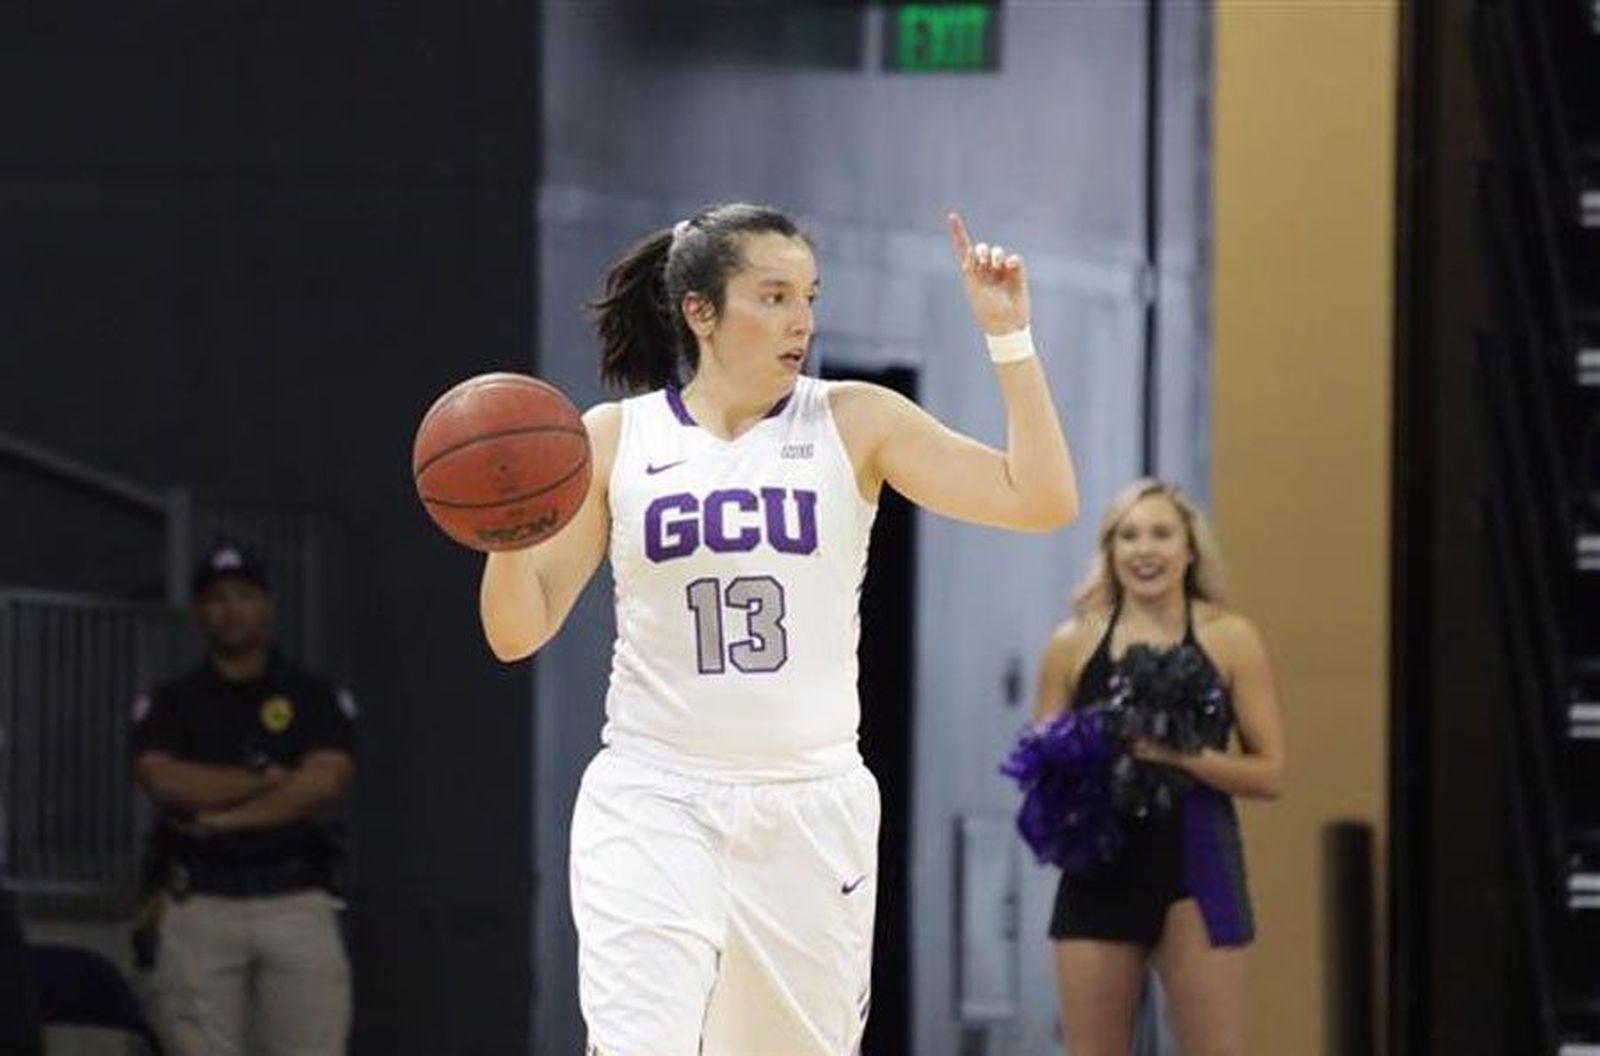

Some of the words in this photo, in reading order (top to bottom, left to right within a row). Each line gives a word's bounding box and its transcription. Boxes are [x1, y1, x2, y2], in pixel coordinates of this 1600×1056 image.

[899, 4, 987, 69] EXIT
[645, 487, 818, 564] GCU
[686, 575, 788, 674] 13
